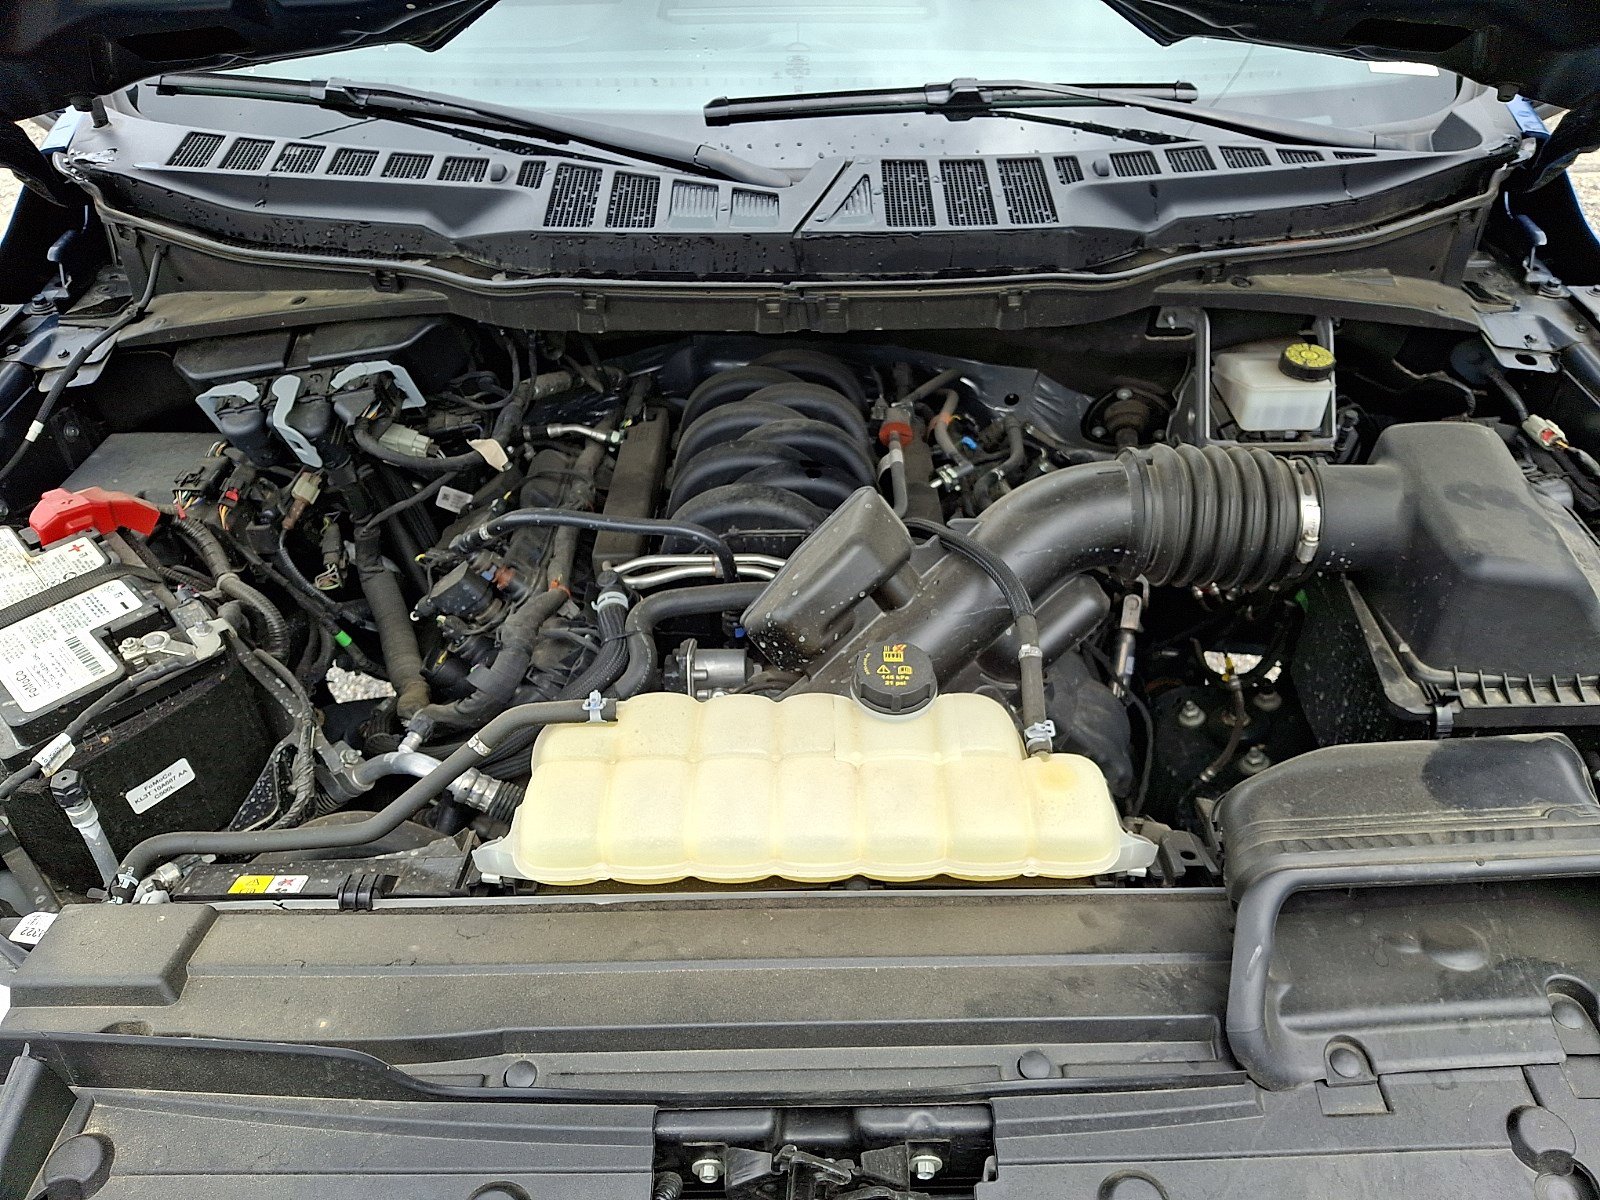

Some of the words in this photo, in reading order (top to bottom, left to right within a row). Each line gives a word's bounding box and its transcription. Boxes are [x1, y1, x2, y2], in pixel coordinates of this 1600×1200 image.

[15, 670, 40, 698] FoMoCo
[143, 772, 172, 791] FoMoCo
[178, 769, 188, 778] AA
